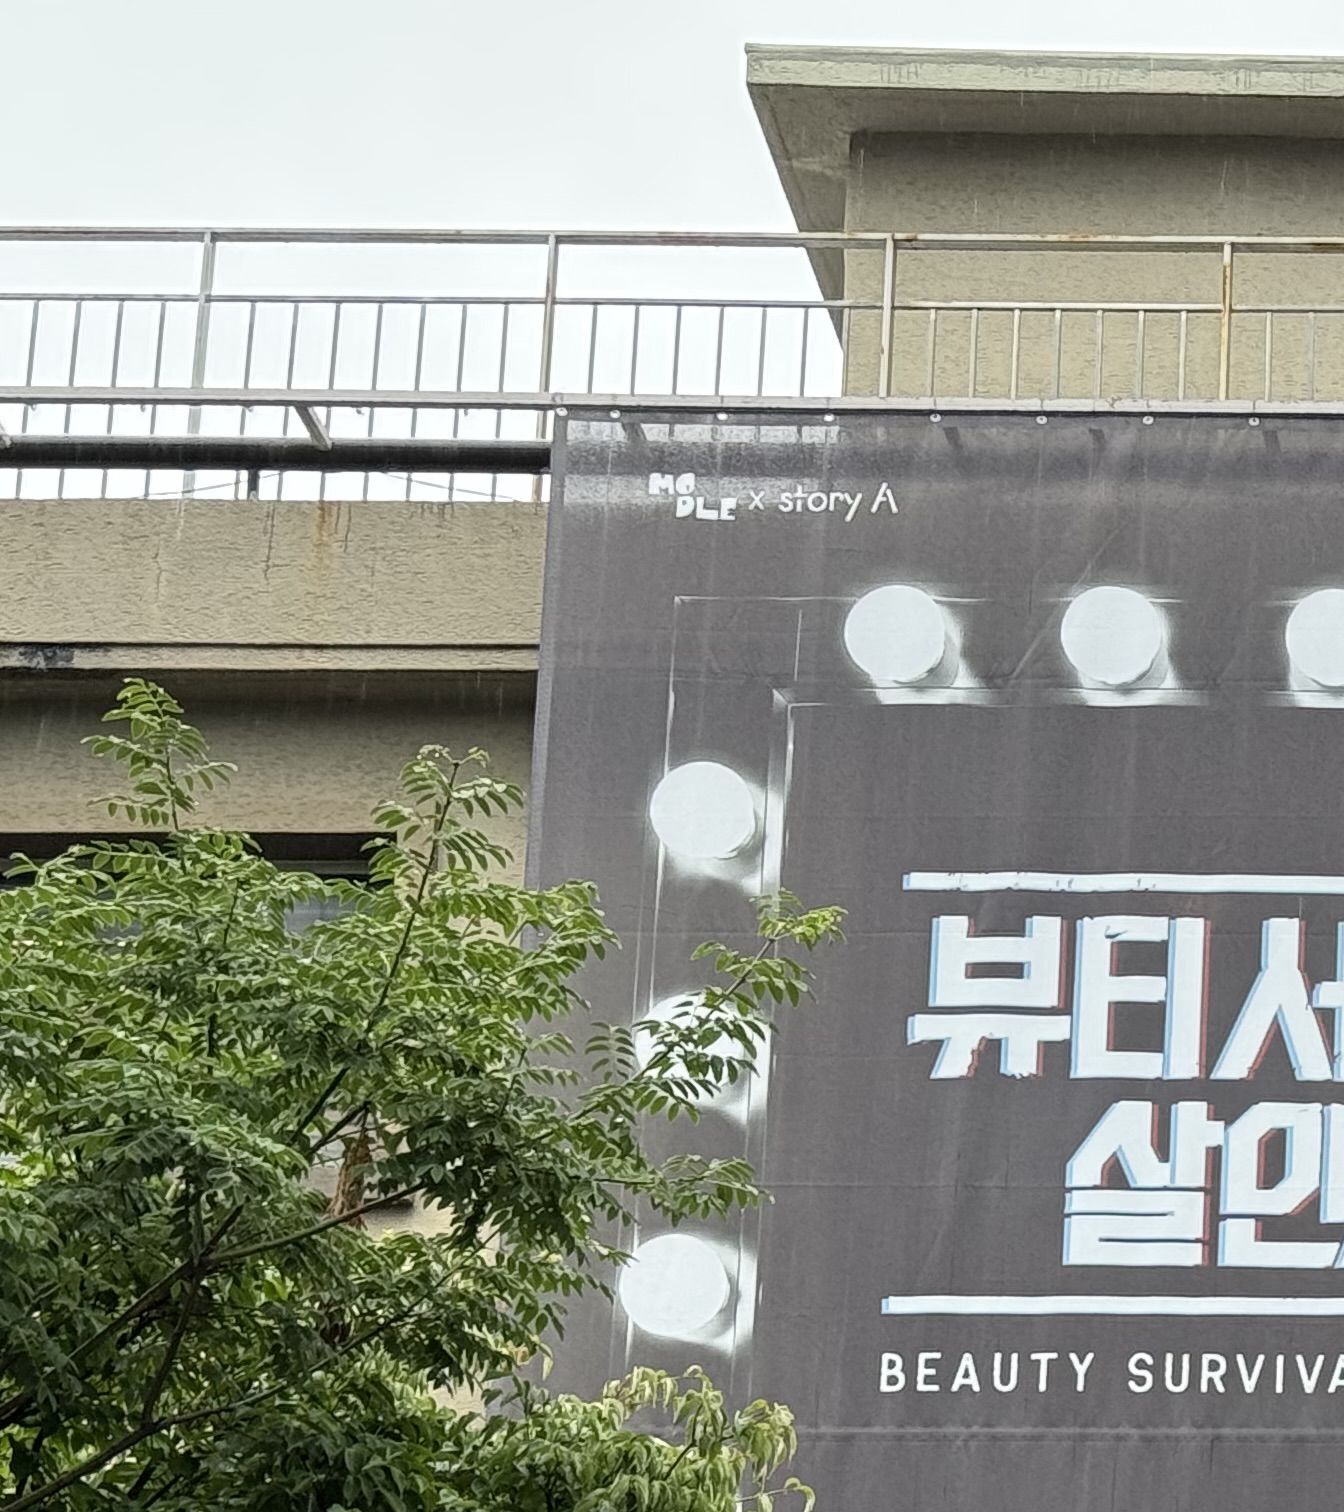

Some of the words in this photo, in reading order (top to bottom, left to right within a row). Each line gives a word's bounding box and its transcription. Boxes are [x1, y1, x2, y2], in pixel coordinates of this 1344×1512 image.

[749, 490, 766, 511] x
[778, 484, 862, 522] story
[870, 482, 899, 514] A
[907, 914, 1210, 1081] 뷰티
[879, 1351, 1098, 1394] BEAUTY
